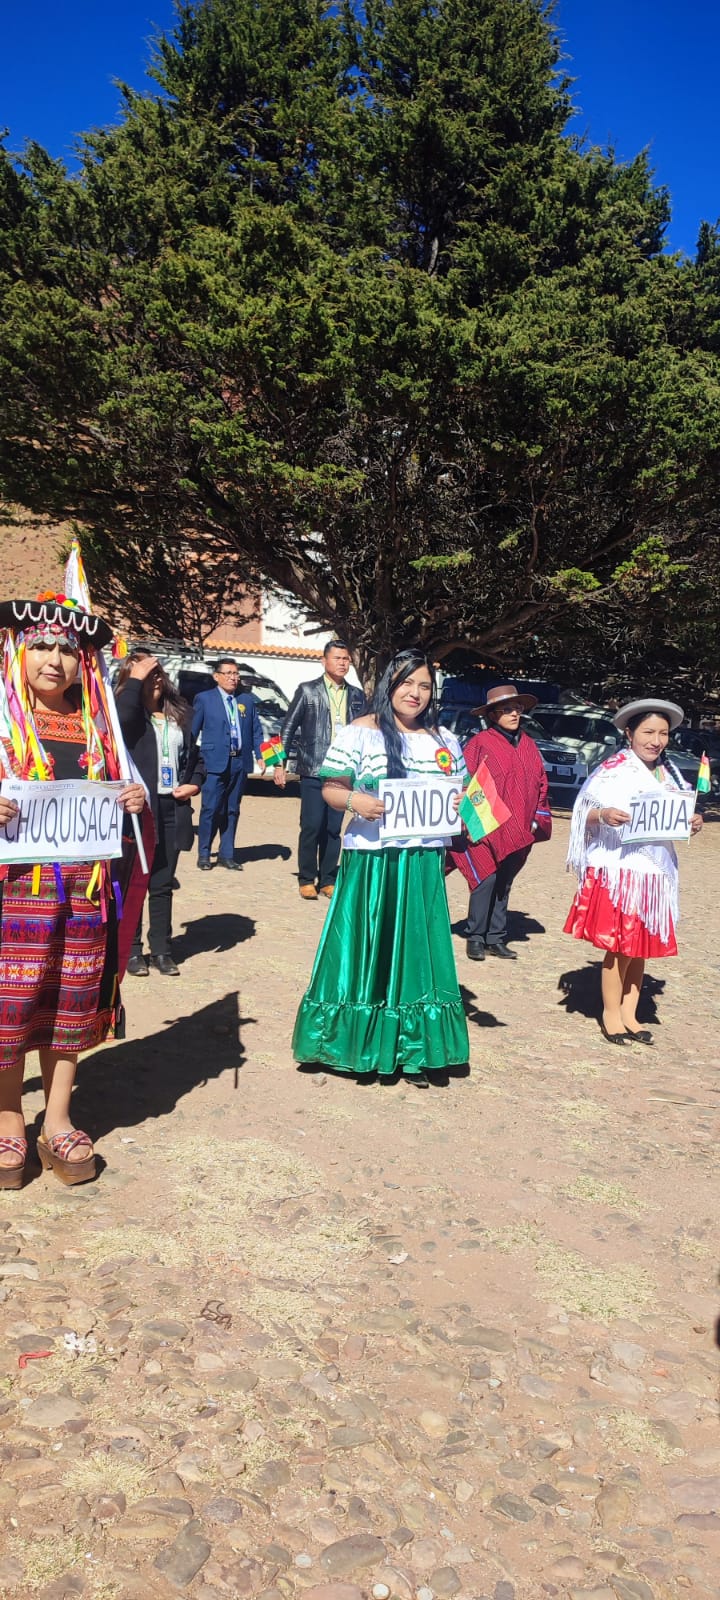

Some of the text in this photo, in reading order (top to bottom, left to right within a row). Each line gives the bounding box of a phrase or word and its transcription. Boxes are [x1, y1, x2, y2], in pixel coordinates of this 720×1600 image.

[4, 797, 119, 848] CHUQUISACA
[383, 788, 459, 829] PANDO
[630, 800, 688, 833] TARIJA
